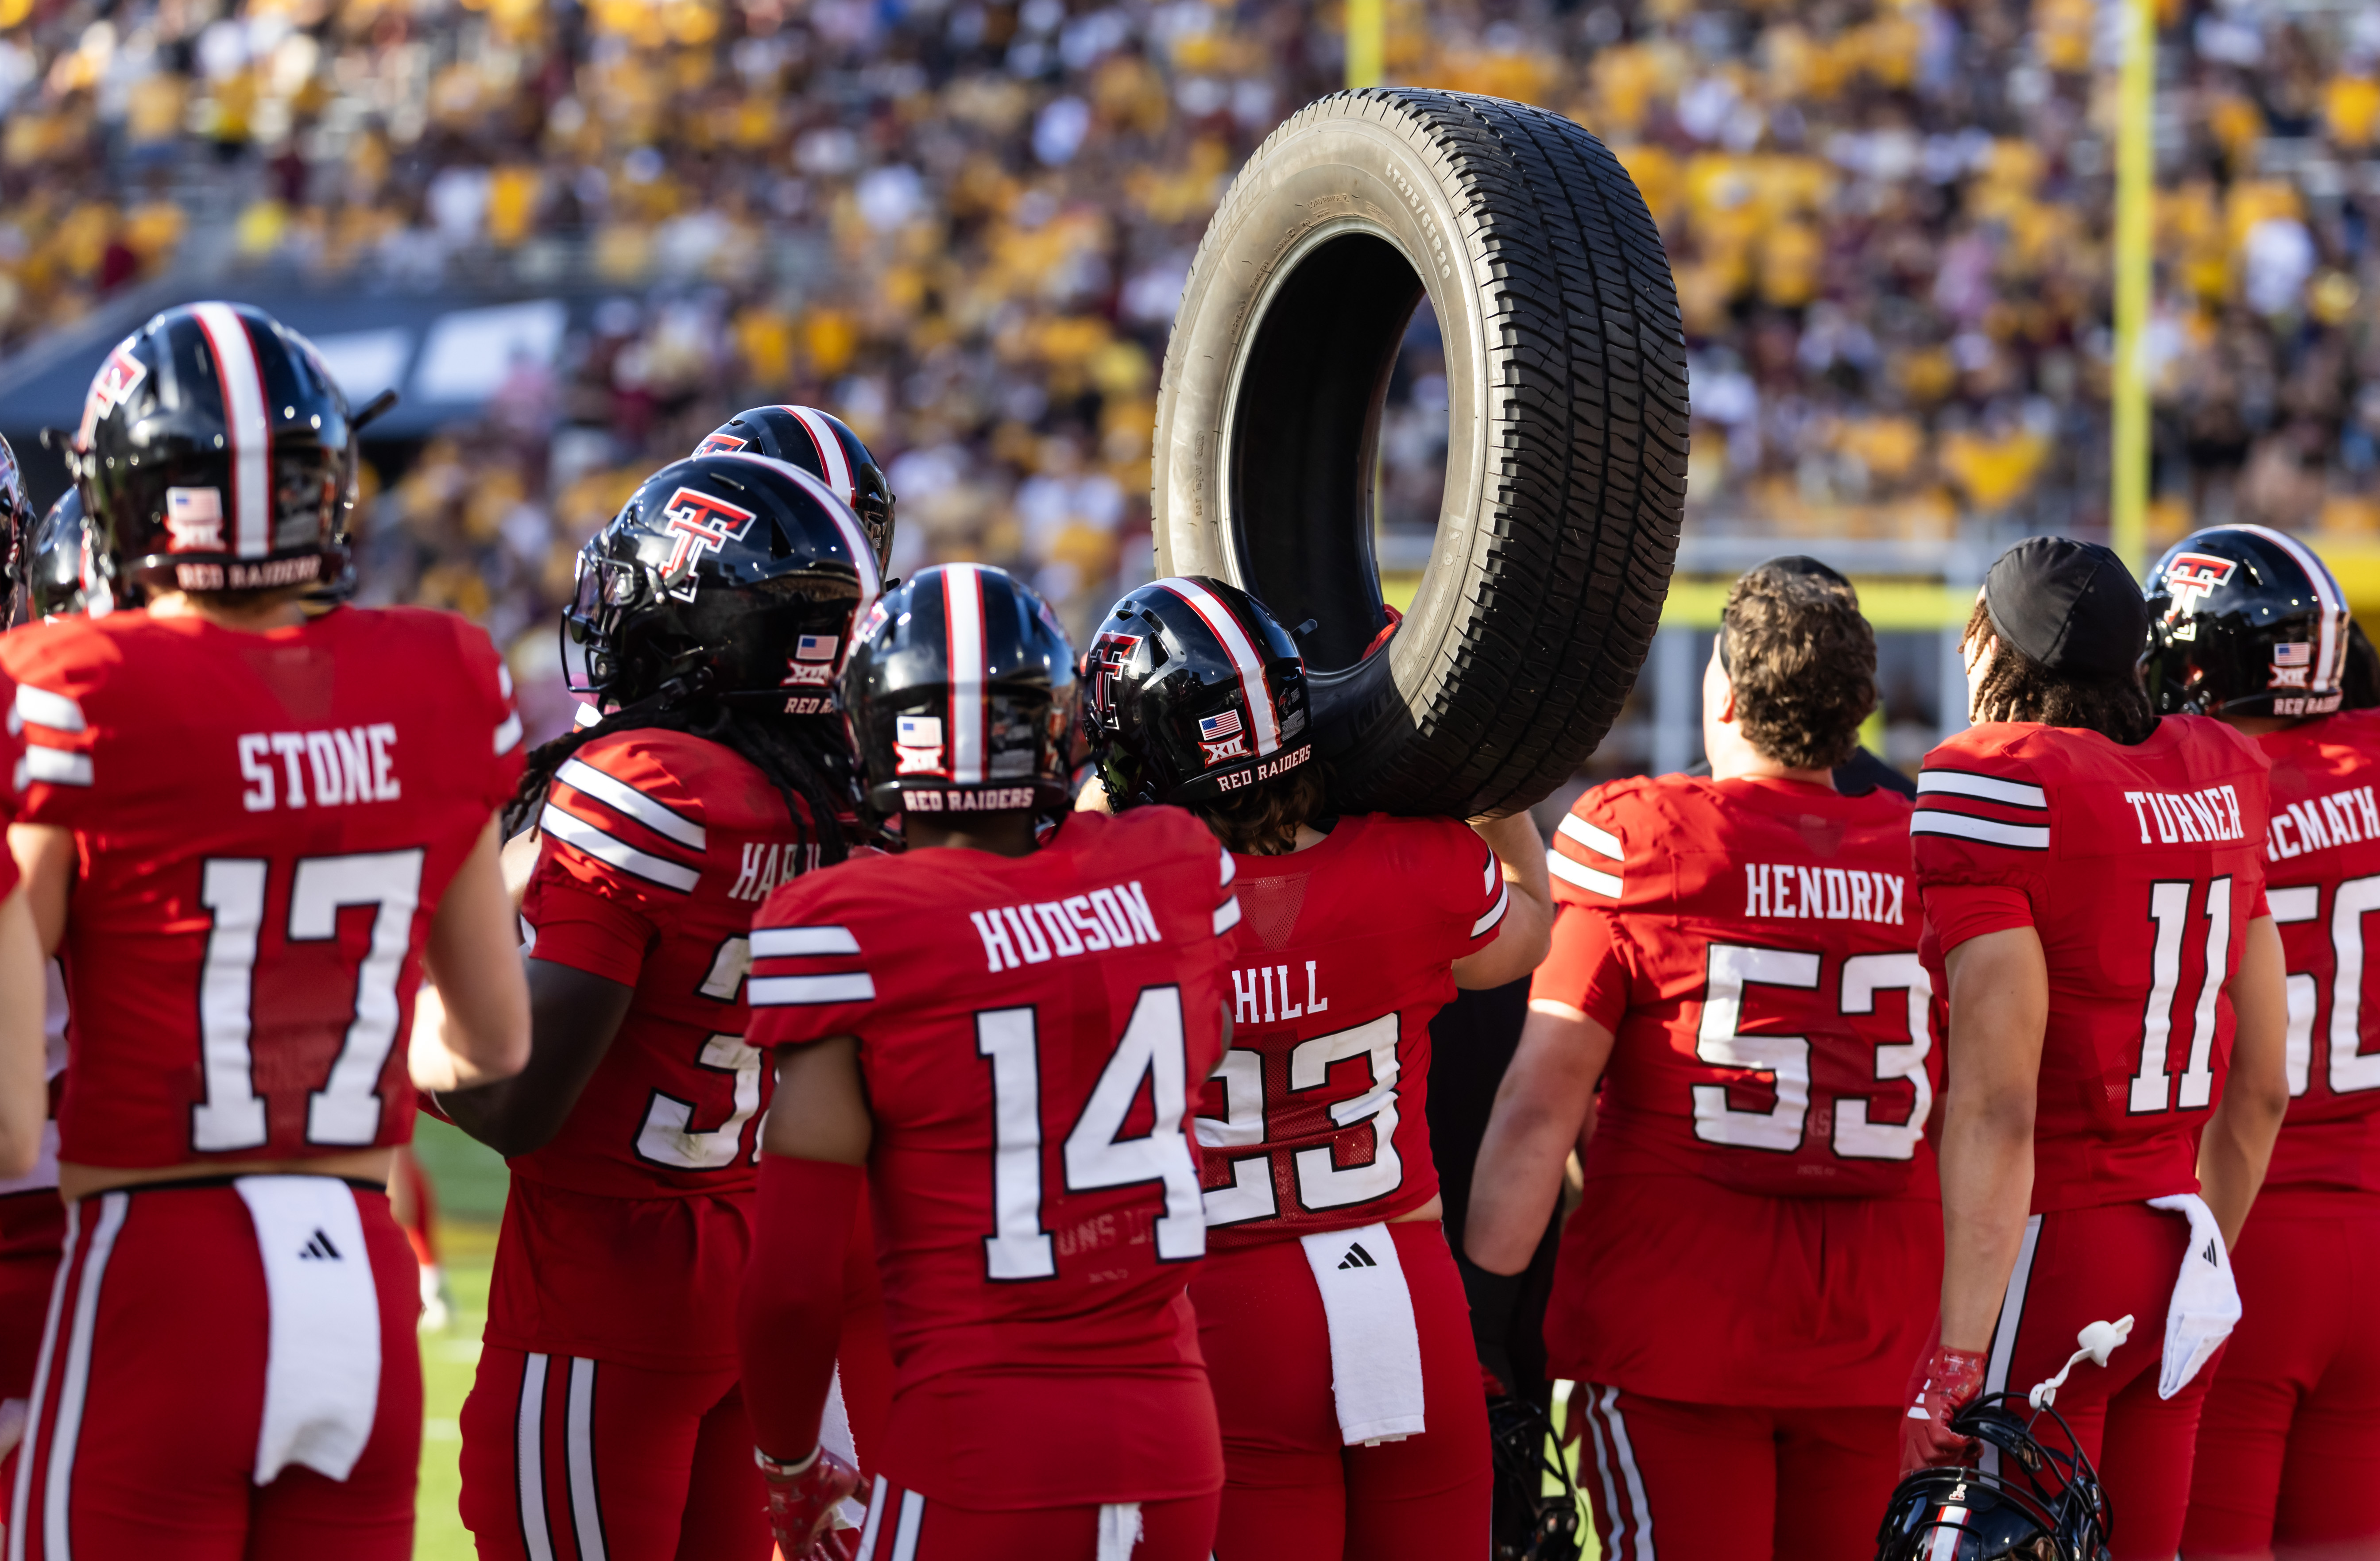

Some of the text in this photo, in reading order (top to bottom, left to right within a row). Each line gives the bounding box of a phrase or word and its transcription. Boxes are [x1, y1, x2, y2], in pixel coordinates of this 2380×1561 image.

[1307, 199, 1323, 209] LOAD
[1323, 194, 1342, 203] RANGE
[1385, 162, 1451, 279] LT275/65R20
[1250, 260, 1269, 289] TUBELESS
[1273, 237, 1290, 254] RADIAL
[783, 697, 820, 714] RED
[237, 723, 402, 812] STONE
[1201, 733, 1250, 765] XII
[1217, 744, 1312, 792] RED RAIDERS
[902, 787, 1035, 812] RED RAIDERS
[2124, 784, 2245, 844] TURNER
[1745, 863, 1905, 925] HENDRIX
[970, 880, 1162, 974] HUDSON
[190, 843, 428, 1152] 17
[1231, 960, 1327, 1023] HILL
[2127, 873, 2233, 1116] 11
[1690, 942, 1935, 1162] 53
[973, 981, 1207, 1283] 14
